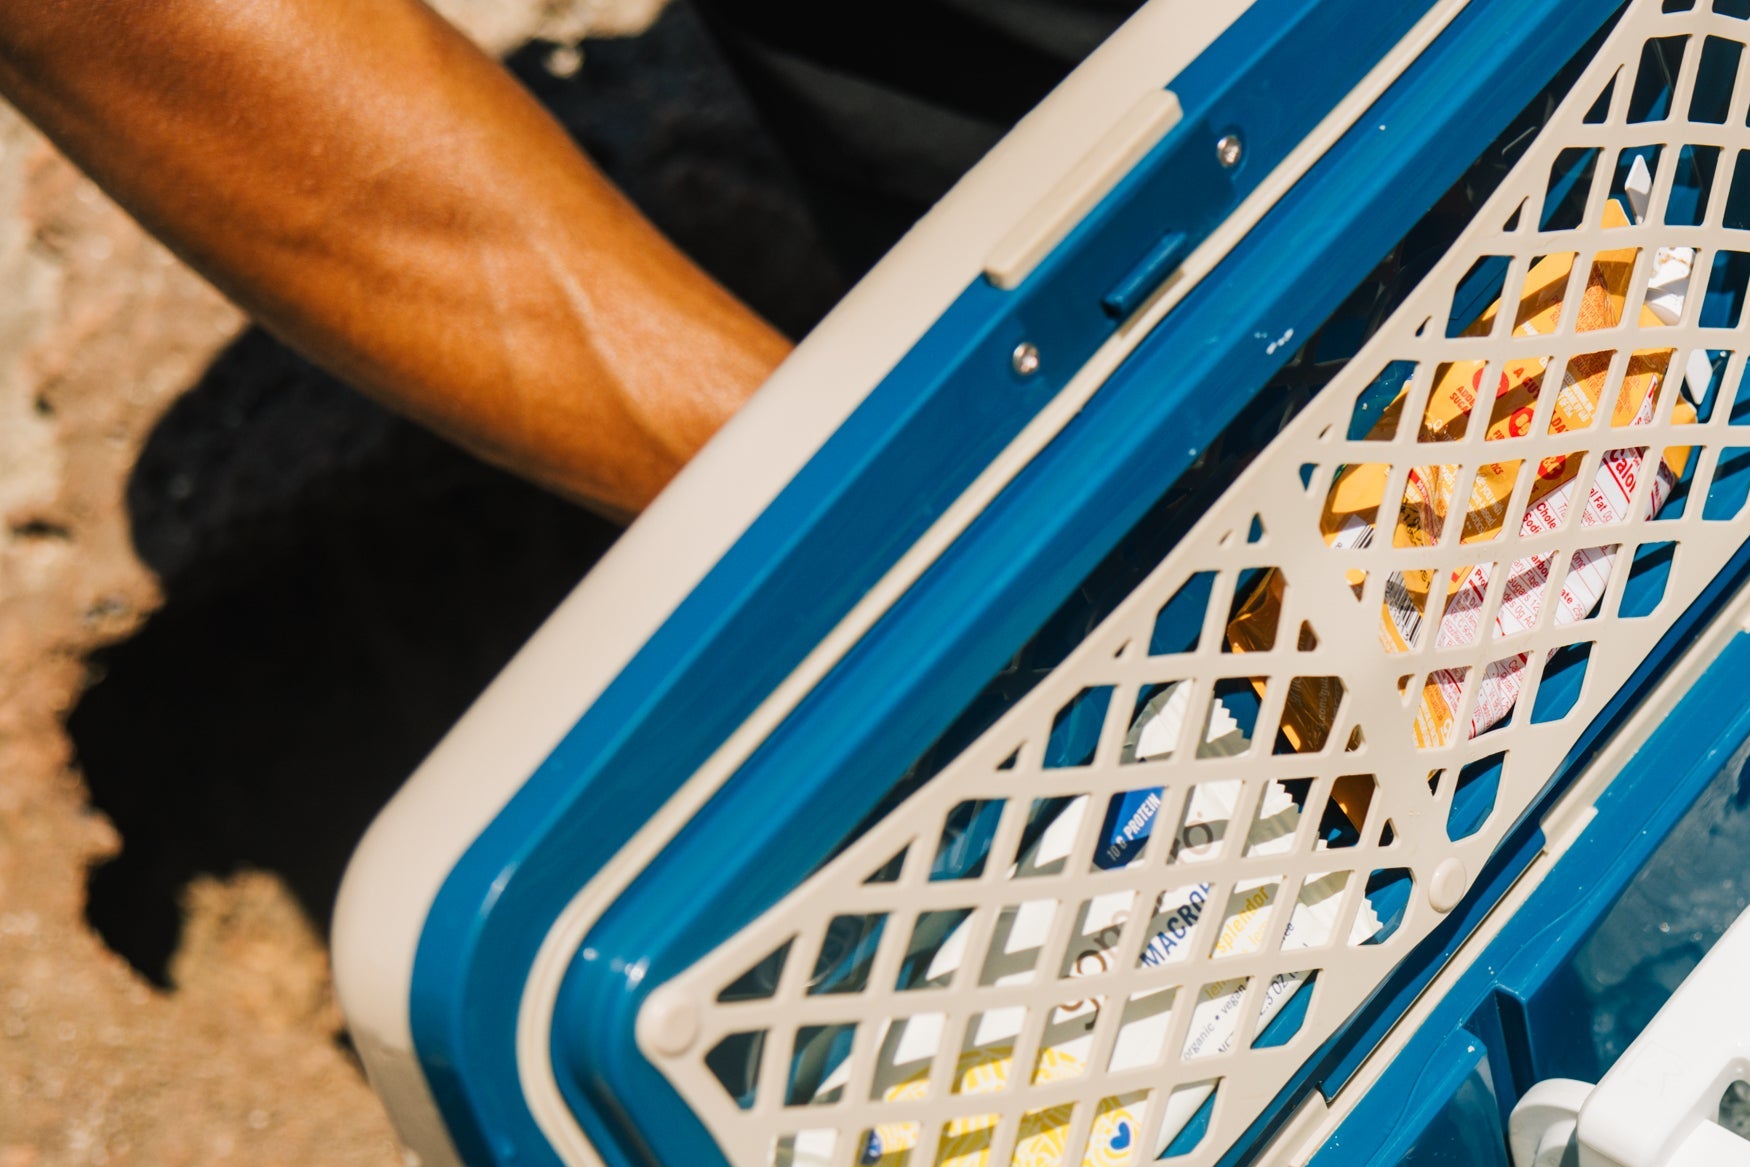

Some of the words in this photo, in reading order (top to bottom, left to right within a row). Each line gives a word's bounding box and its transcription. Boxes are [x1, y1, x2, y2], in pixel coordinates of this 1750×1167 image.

[1513, 367, 1525, 378] A
[1593, 496, 1608, 512] Fat
[1123, 793, 1162, 840] PROTEIN
